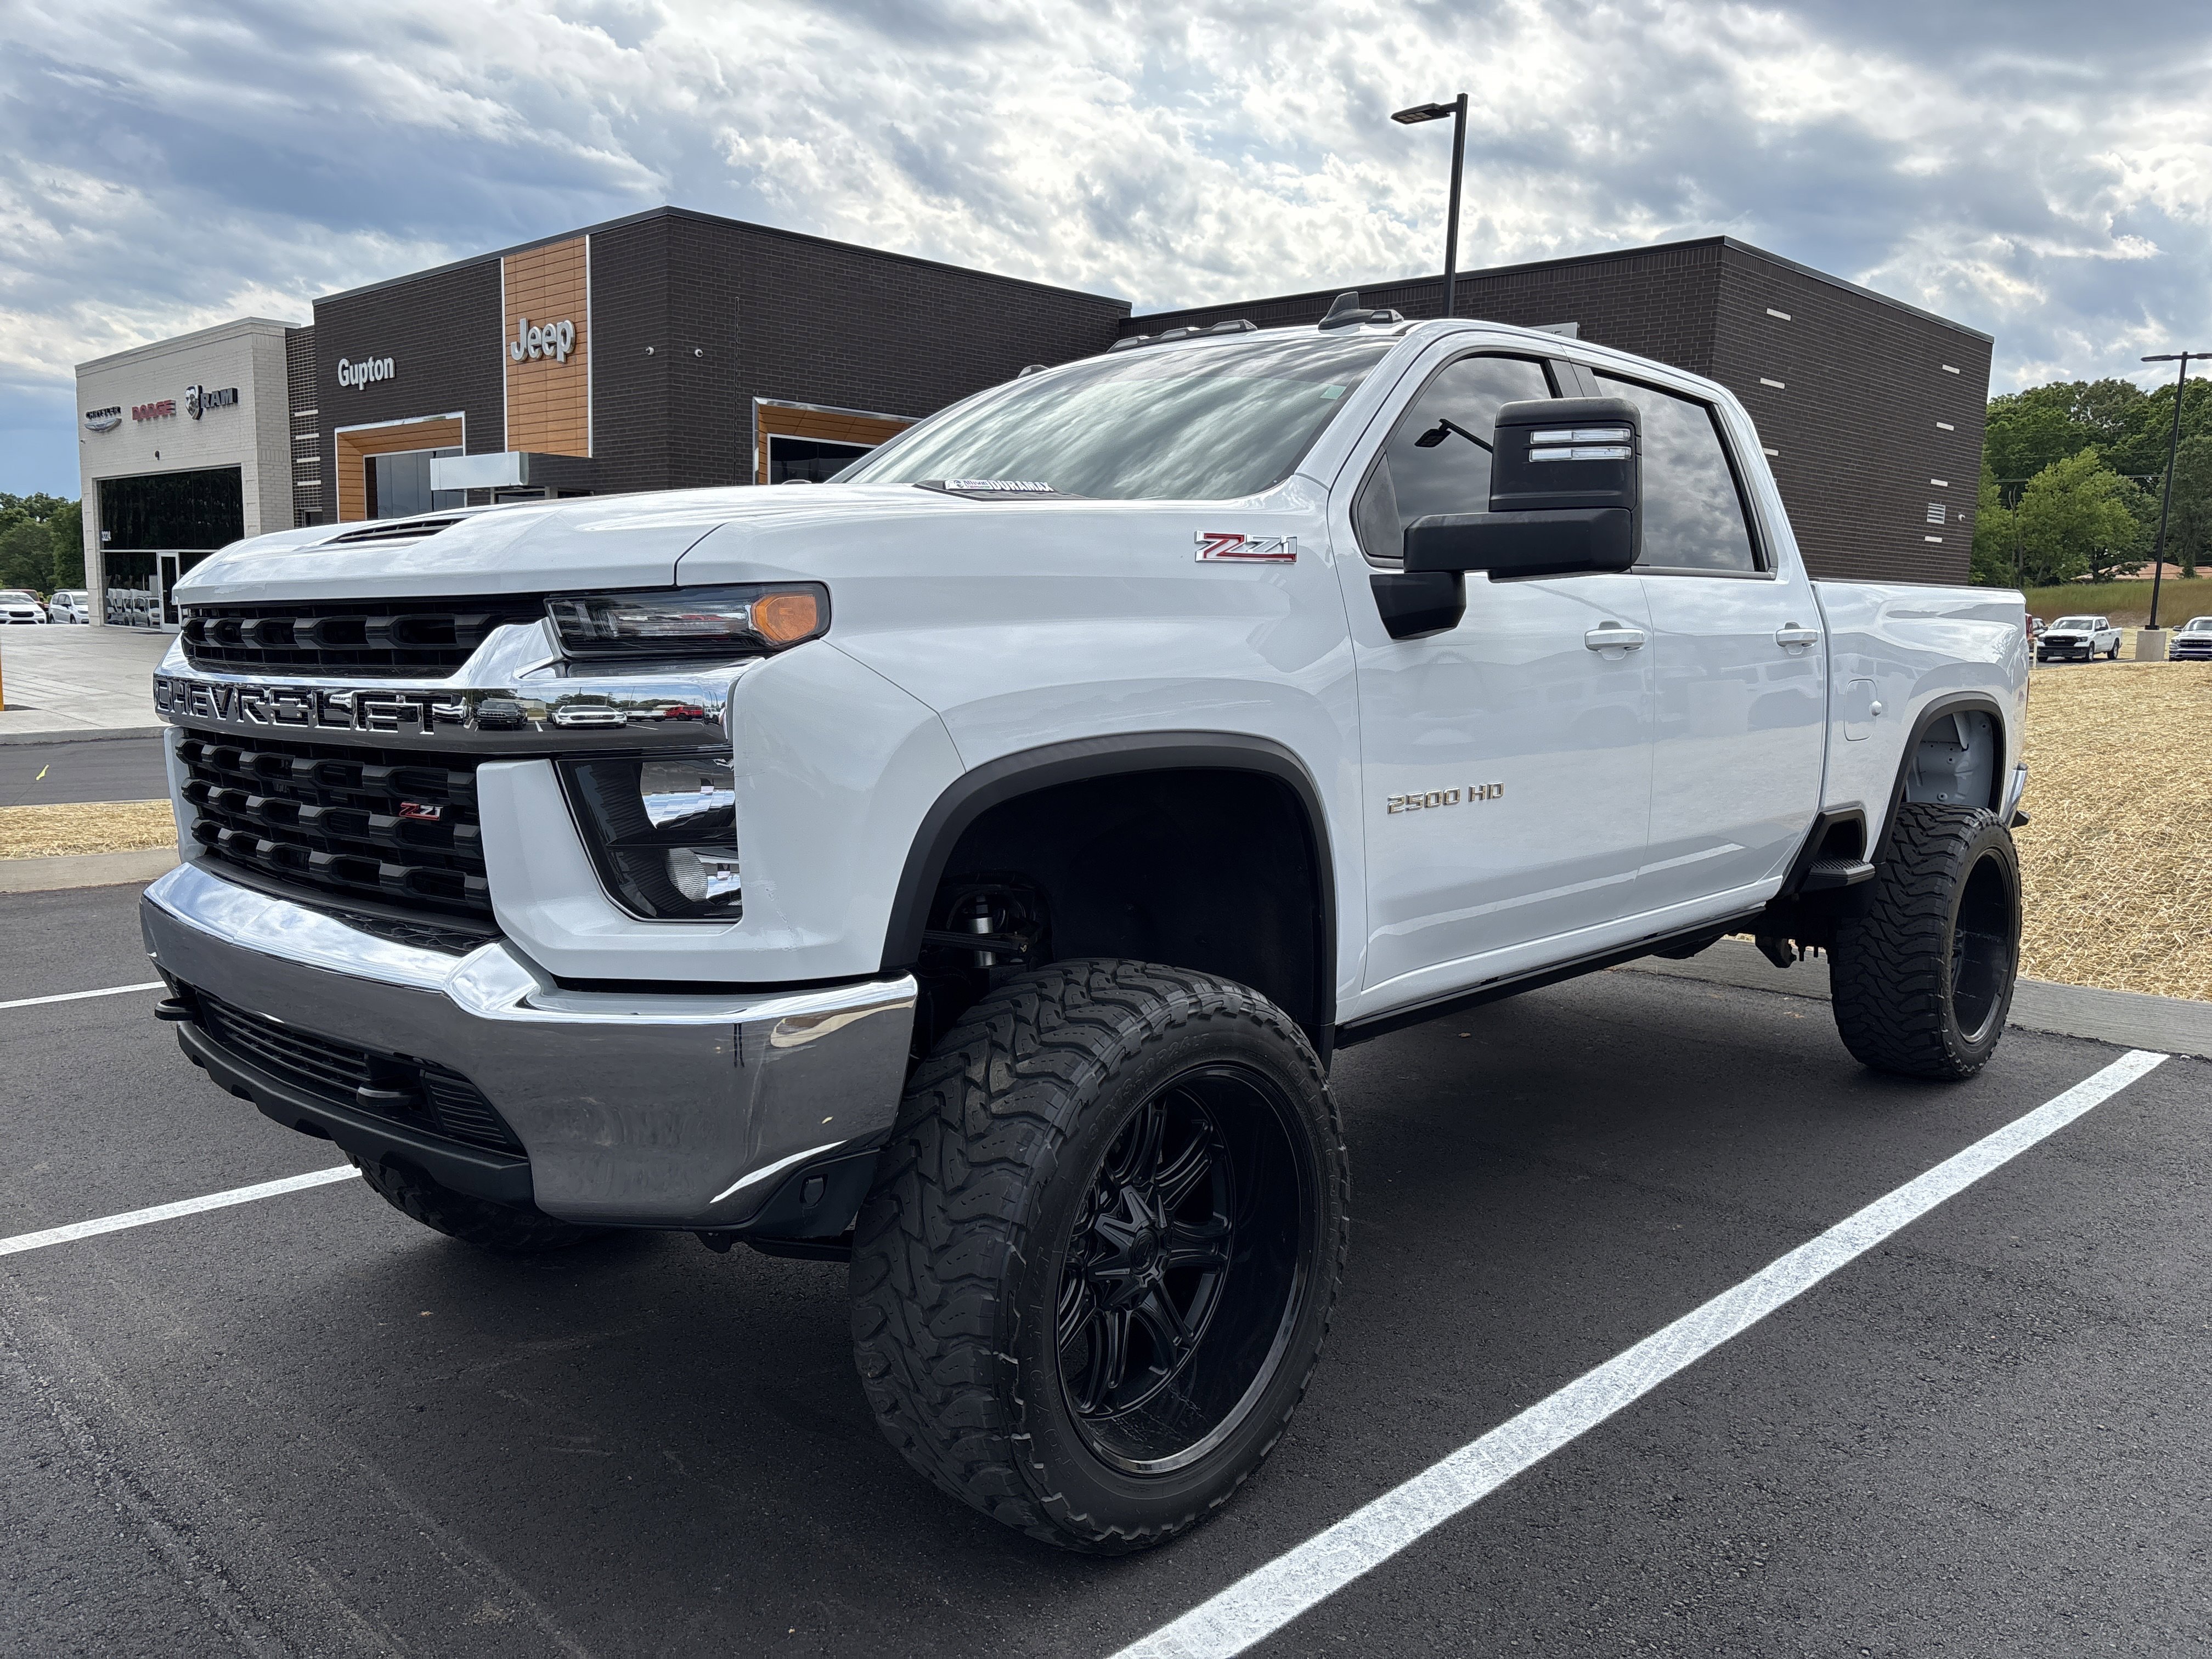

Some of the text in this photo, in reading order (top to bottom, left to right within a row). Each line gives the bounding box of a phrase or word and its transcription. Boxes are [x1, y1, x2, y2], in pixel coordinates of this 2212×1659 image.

[510, 318, 575, 363] Jeep
[337, 356, 396, 391] Gupton
[132, 399, 176, 421] DODGE
[200, 388, 238, 408] RAM
[86, 406, 121, 419] CHRYSLER
[988, 480, 1054, 492] DURAMAX
[1194, 531, 1297, 564] Z71
[155, 678, 462, 735] CHEVROLET
[1387, 781, 1505, 814] 2500 HD
[398, 802, 444, 821] Z71
